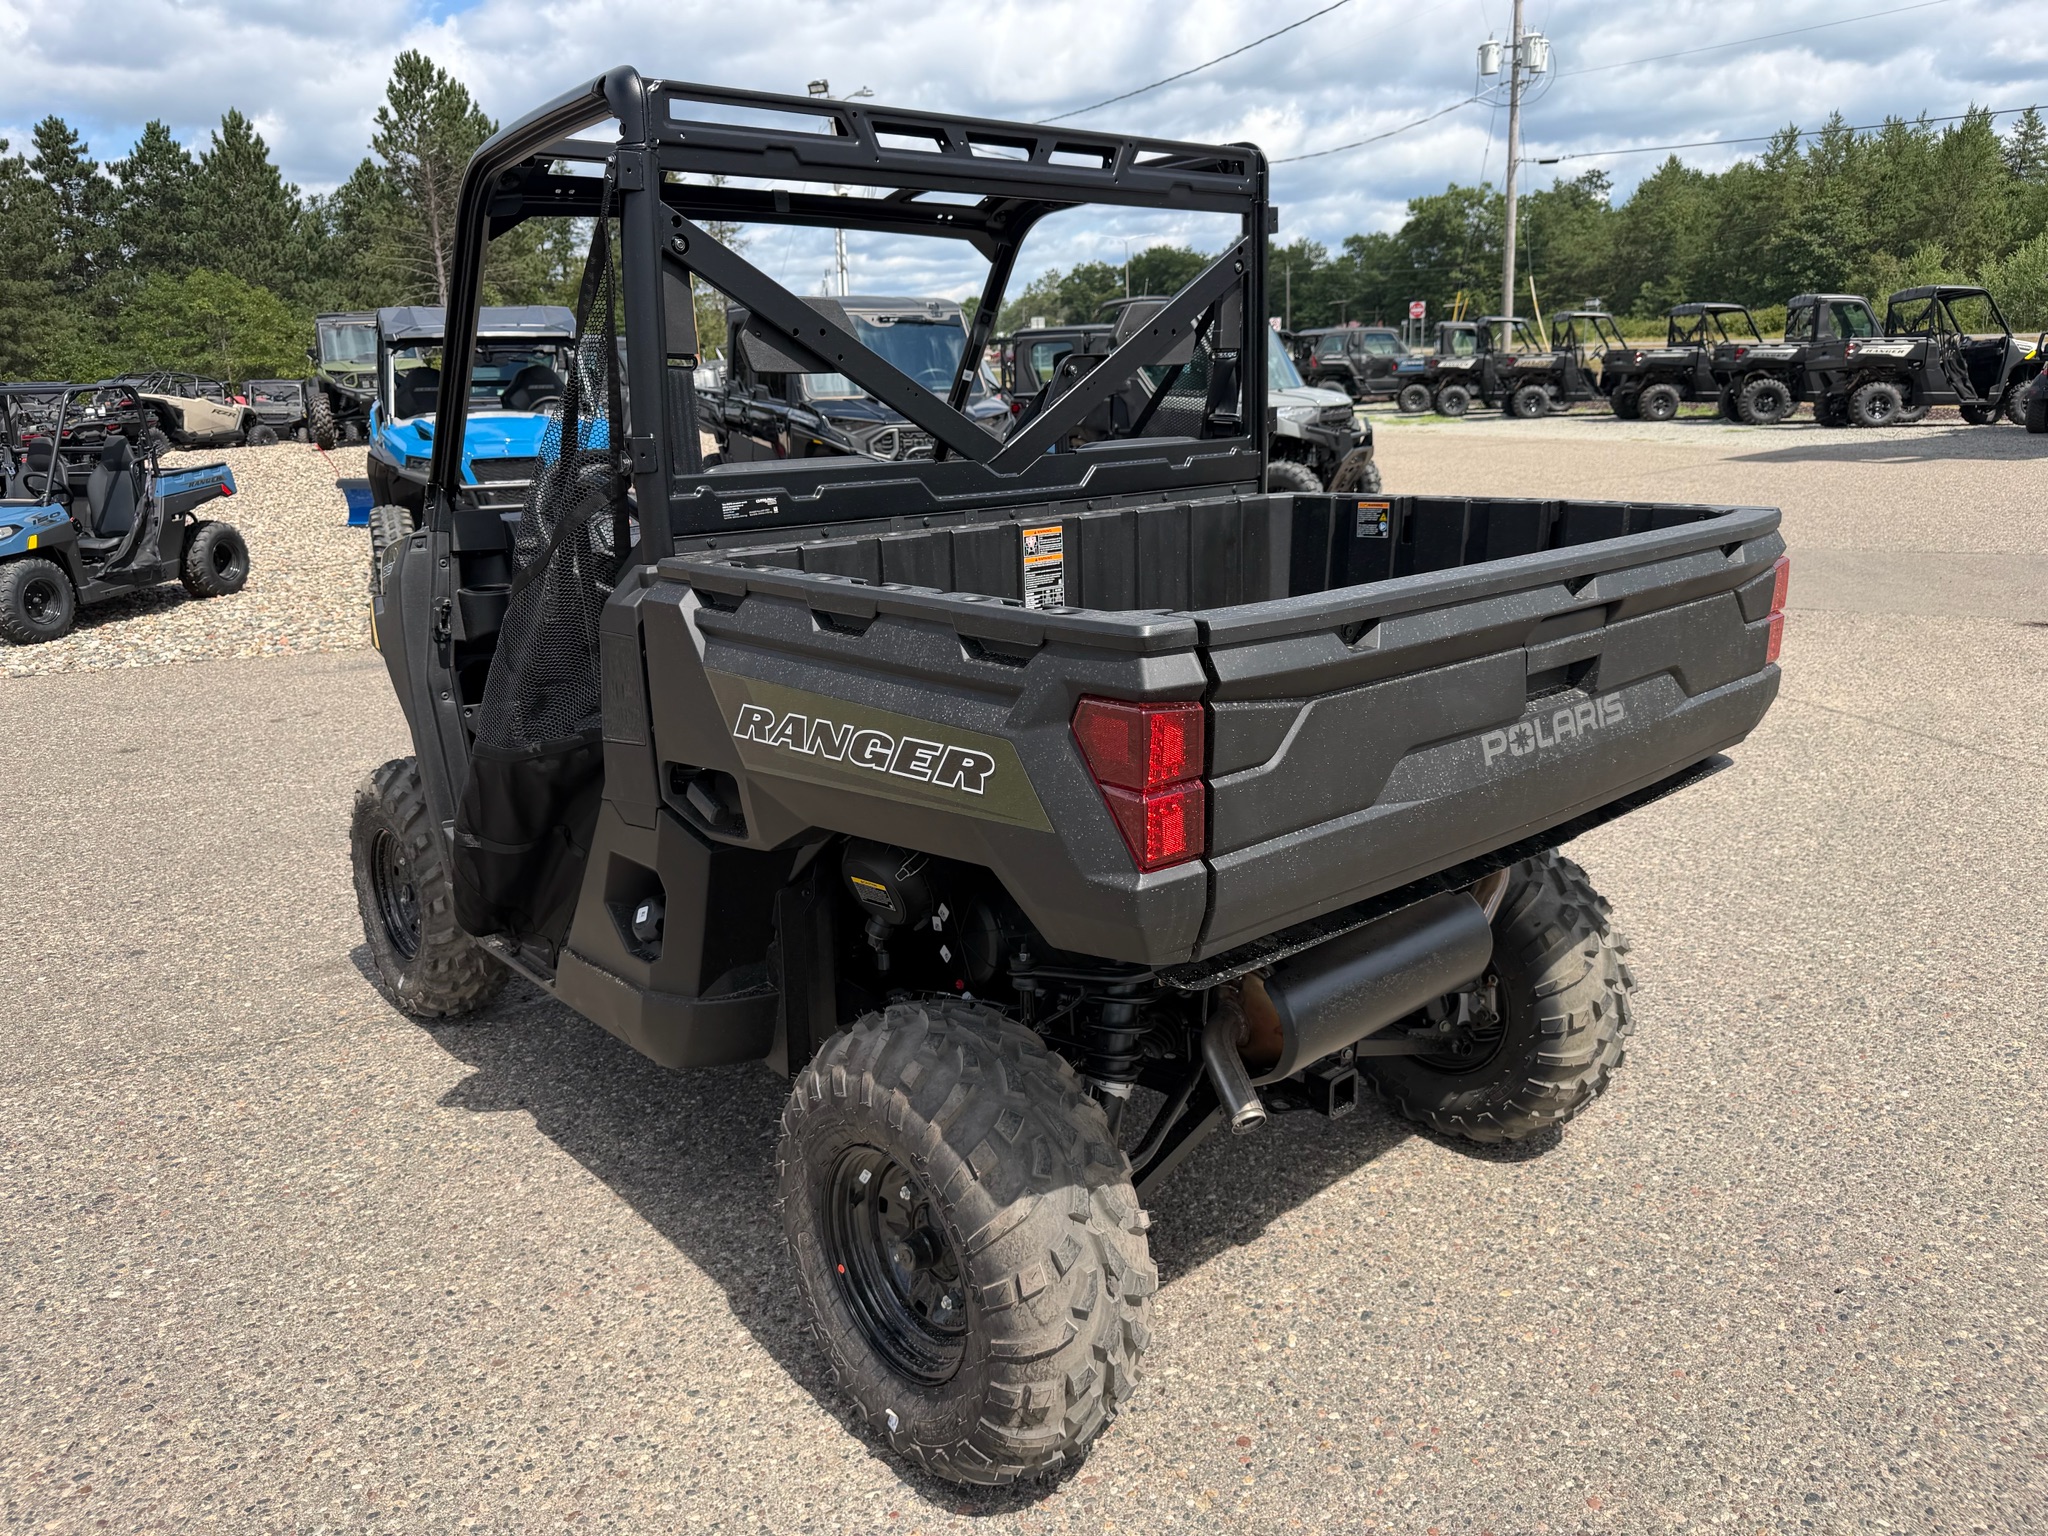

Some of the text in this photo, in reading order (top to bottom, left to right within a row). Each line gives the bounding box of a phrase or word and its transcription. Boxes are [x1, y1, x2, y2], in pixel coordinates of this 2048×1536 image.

[211, 408, 237, 418] RZR
[733, 703, 996, 795] RANGER
[1481, 692, 1625, 766] POLARIS
